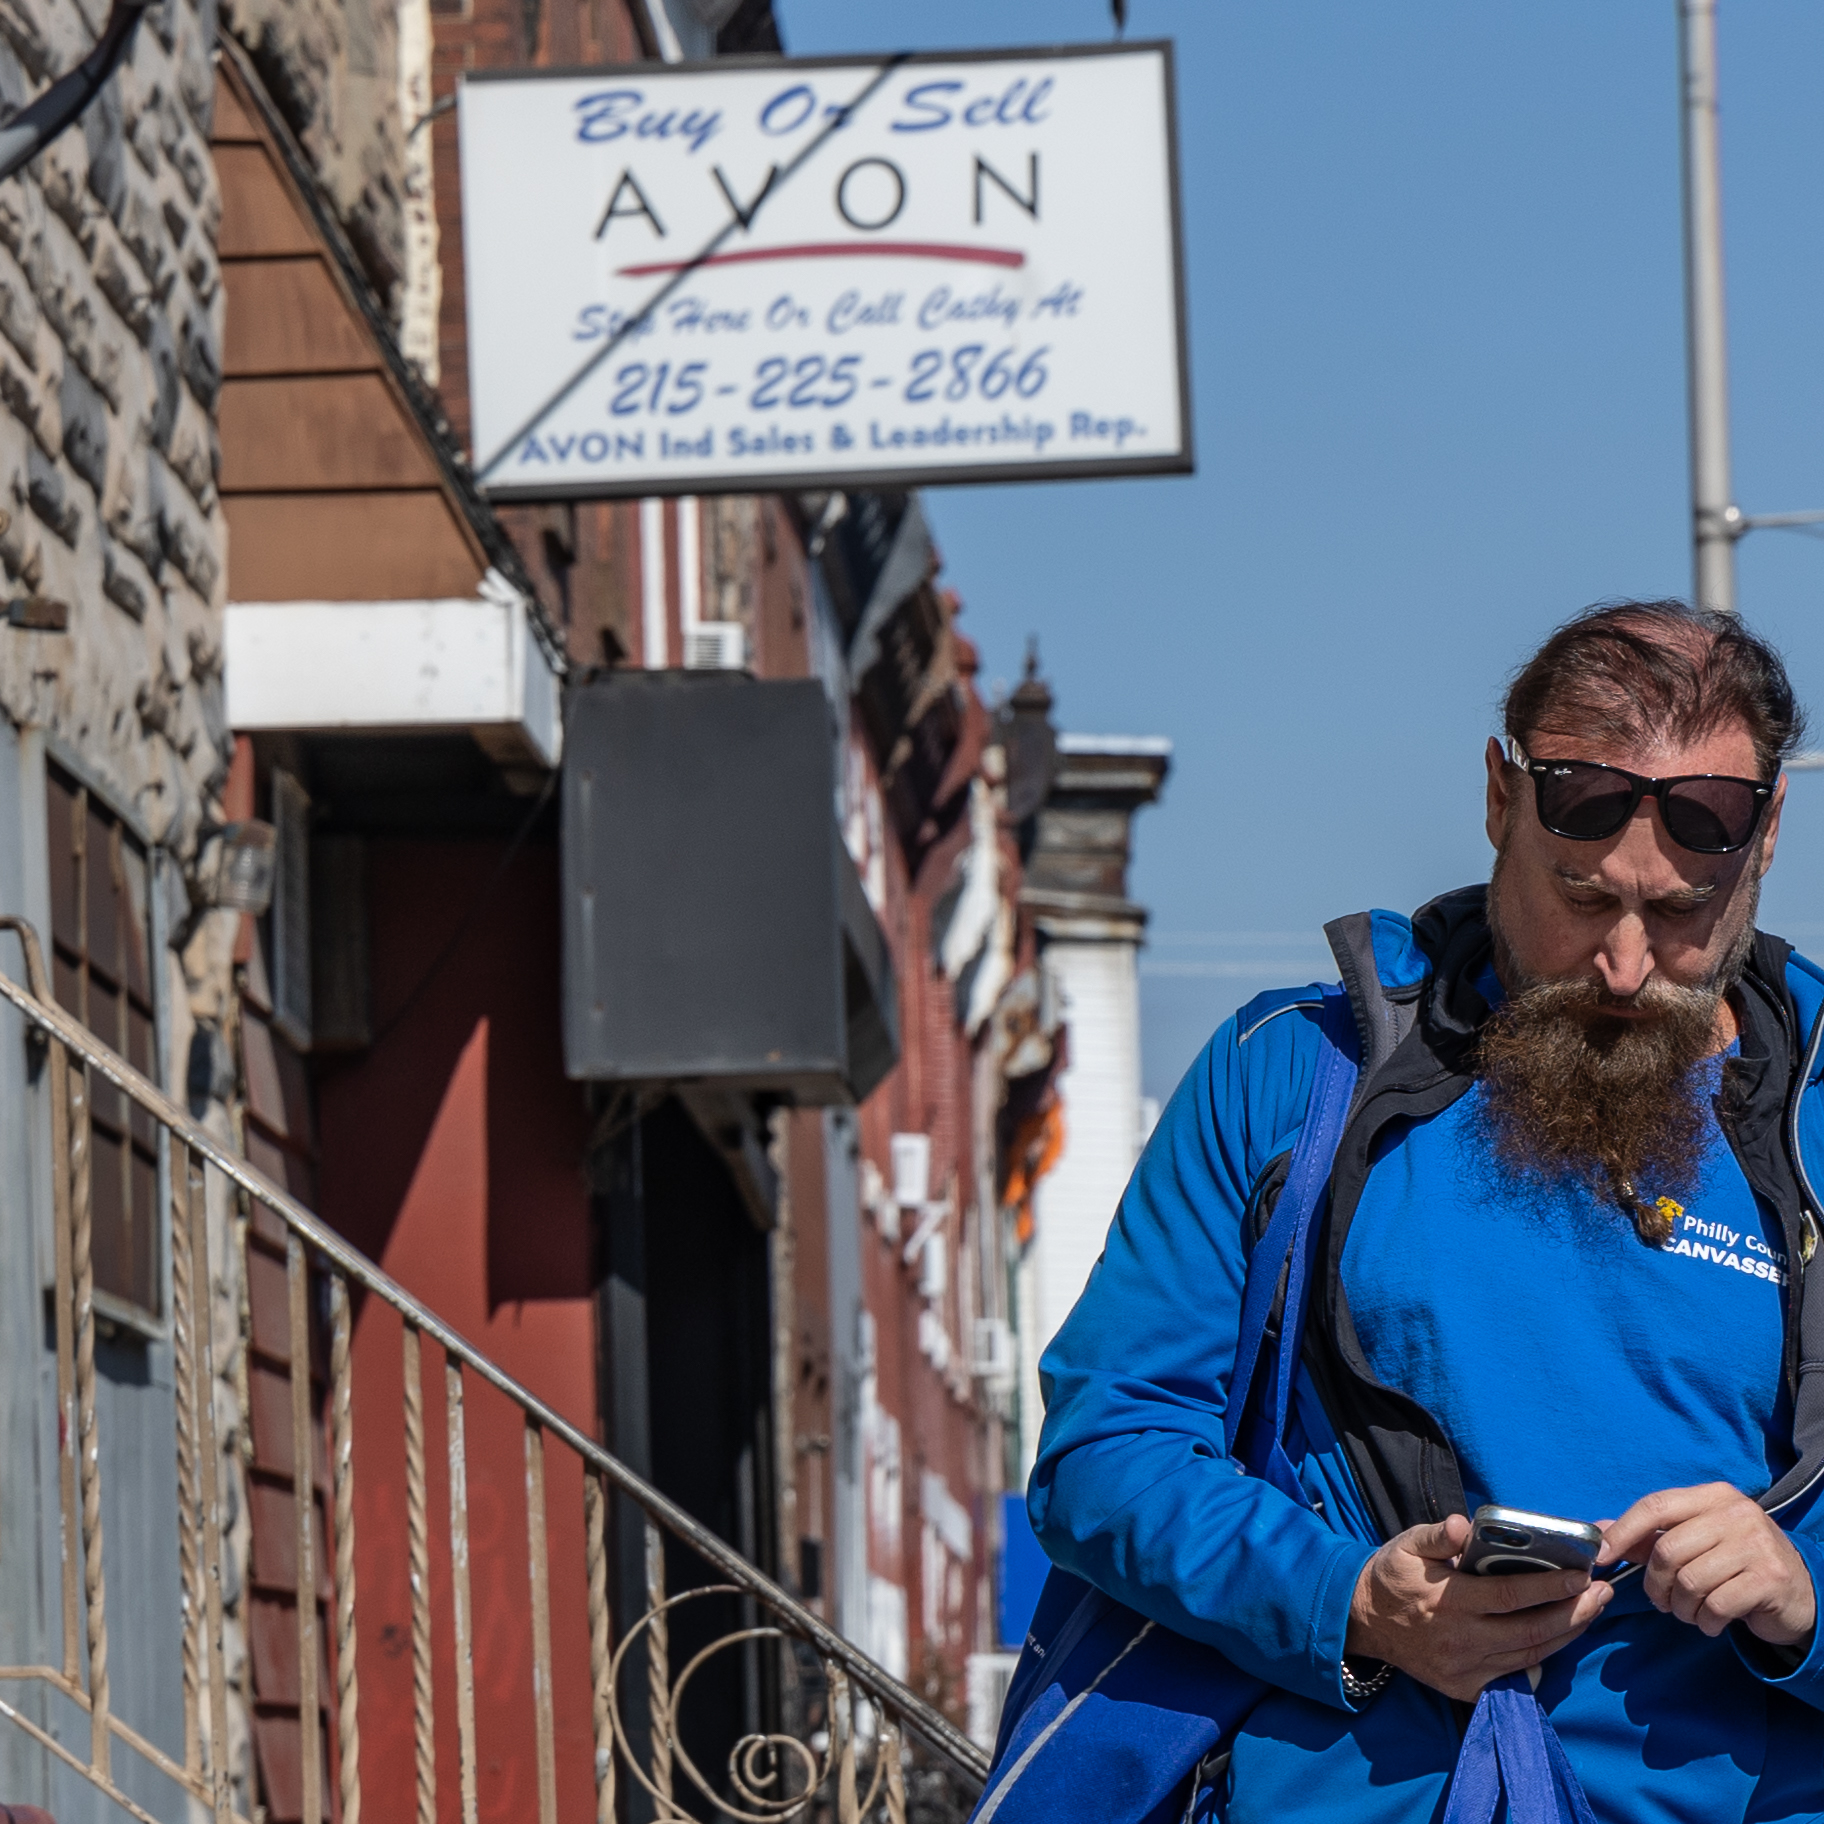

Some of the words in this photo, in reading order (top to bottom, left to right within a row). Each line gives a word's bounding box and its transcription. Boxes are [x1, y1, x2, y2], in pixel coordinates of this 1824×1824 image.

[573, 87, 722, 152] Buy
[760, 83, 853, 137] Or
[890, 77, 1053, 133] Sell
[593, 152, 1042, 241] AVON
[666, 297, 751, 336] Here
[765, 296, 810, 331] Or
[826, 291, 905, 335] Call
[917, 283, 1020, 330] Cathy
[1028, 280, 1084, 320] At
[520, 431, 645, 465] AVON
[660, 430, 714, 459] Ind
[728, 425, 814, 458] Sales
[830, 423, 856, 452] &
[869, 415, 1054, 457] Leadership
[1069, 411, 1149, 445] Rep.
[1683, 1215, 1740, 1247] Philly
[1745, 1235, 1787, 1266] Coun
